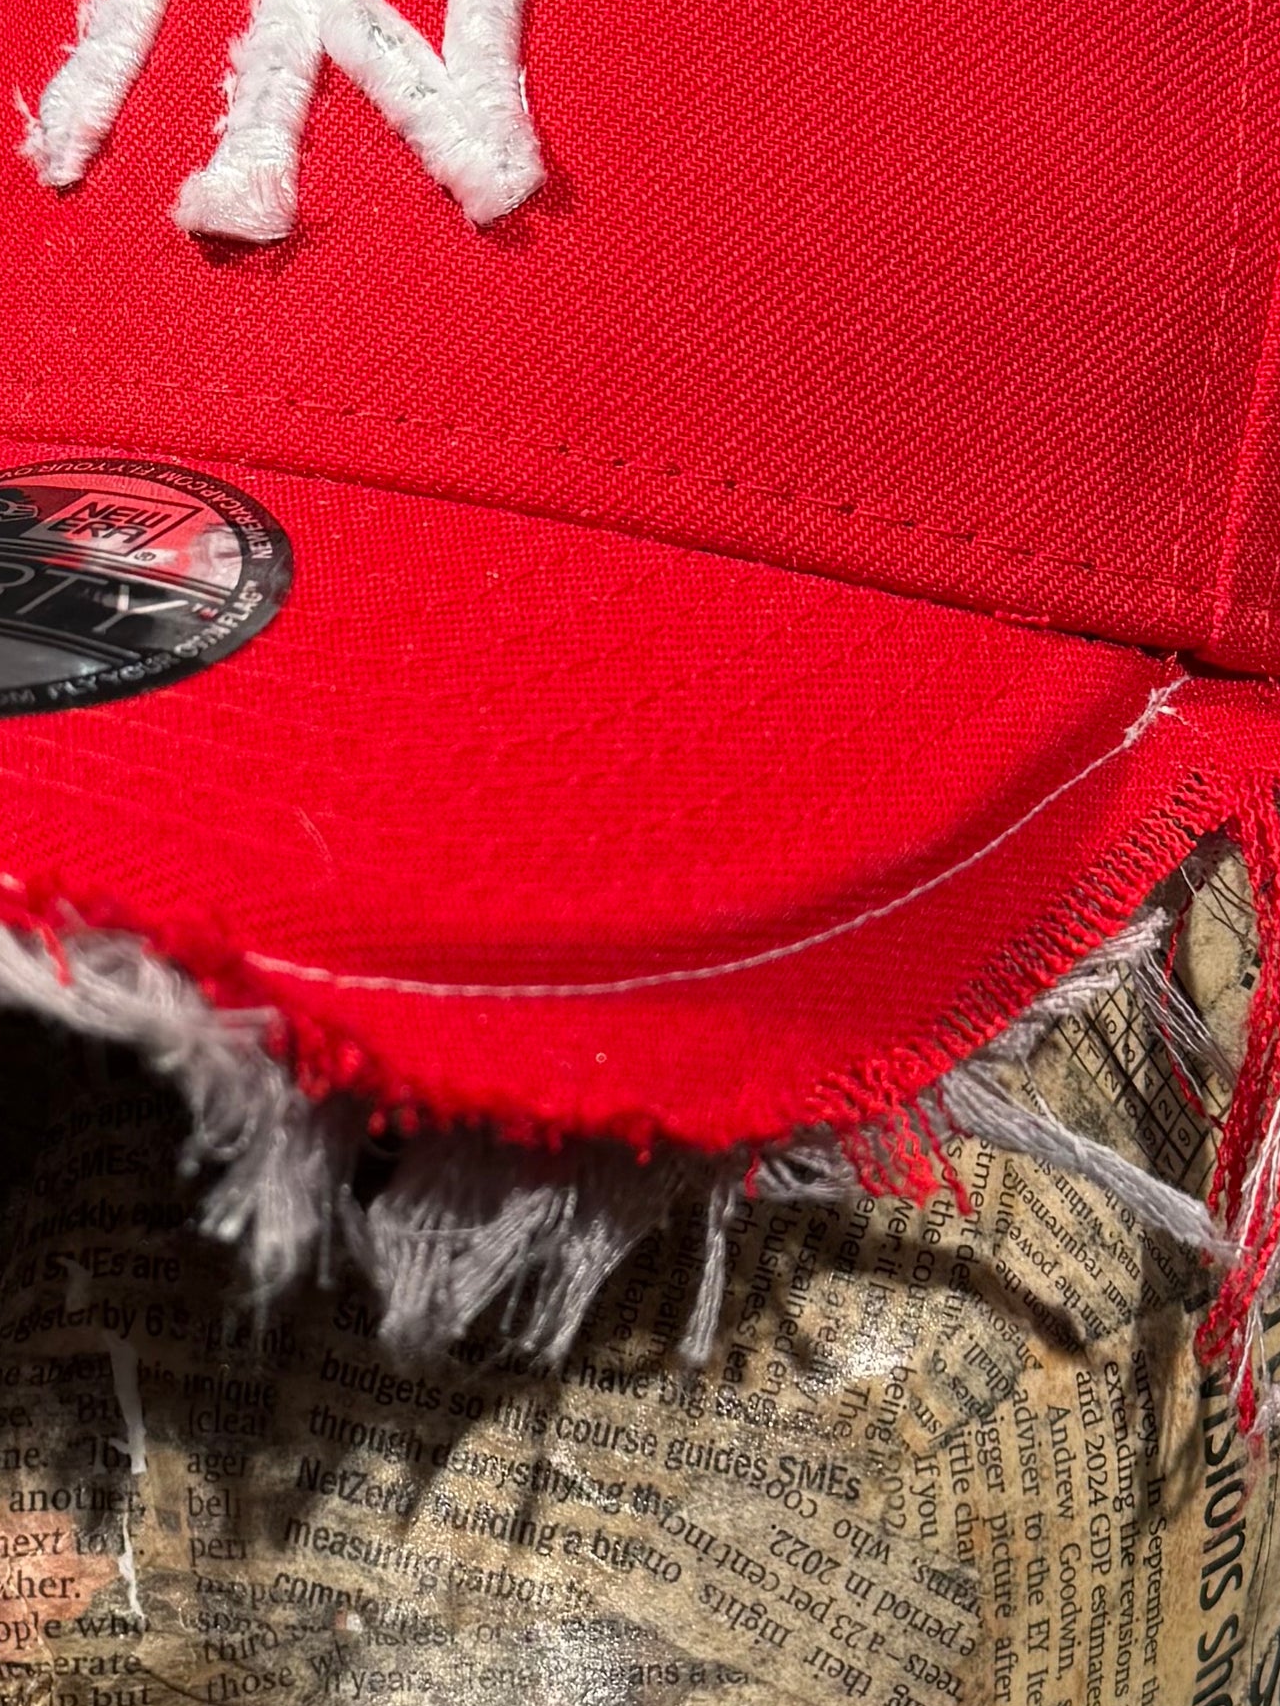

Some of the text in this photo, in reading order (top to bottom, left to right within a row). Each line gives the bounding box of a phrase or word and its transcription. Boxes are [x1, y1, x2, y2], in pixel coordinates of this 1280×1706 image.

[46, 518, 148, 545] ERA
[78, 500, 173, 529] NEW
[320, 1351, 442, 1411] budgets
[448, 1393, 485, 1422] so
[556, 1412, 659, 1459] course
[664, 1435, 771, 1487] guides
[831, 1385, 871, 1440] The
[865, 1363, 917, 1444] being
[1075, 1370, 1104, 1430] and
[1131, 1349, 1160, 1468] surveys.
[308, 1404, 422, 1465] through
[1012, 1388, 1043, 1498] adviser
[1047, 1404, 1077, 1520] Andrew
[1104, 1360, 1136, 1513] extending
[1083, 1436, 1109, 1509] 2024
[1148, 1473, 1167, 1507] In
[833, 1518, 894, 1566] who
[1024, 1511, 1042, 1542] to
[1089, 1511, 1112, 1576] GDP
[1118, 1521, 1137, 1568] the
[771, 1524, 963, 1650] period in 2022.
[1026, 1555, 1051, 1608] the
[1054, 1542, 1083, 1681] Goodwin,
[1142, 1515, 1168, 1666] September
[697, 1581, 795, 1649] nights
[1028, 1617, 1051, 1654] EY
[1114, 1576, 1136, 1697] revisions
[801, 1644, 875, 1701] their
